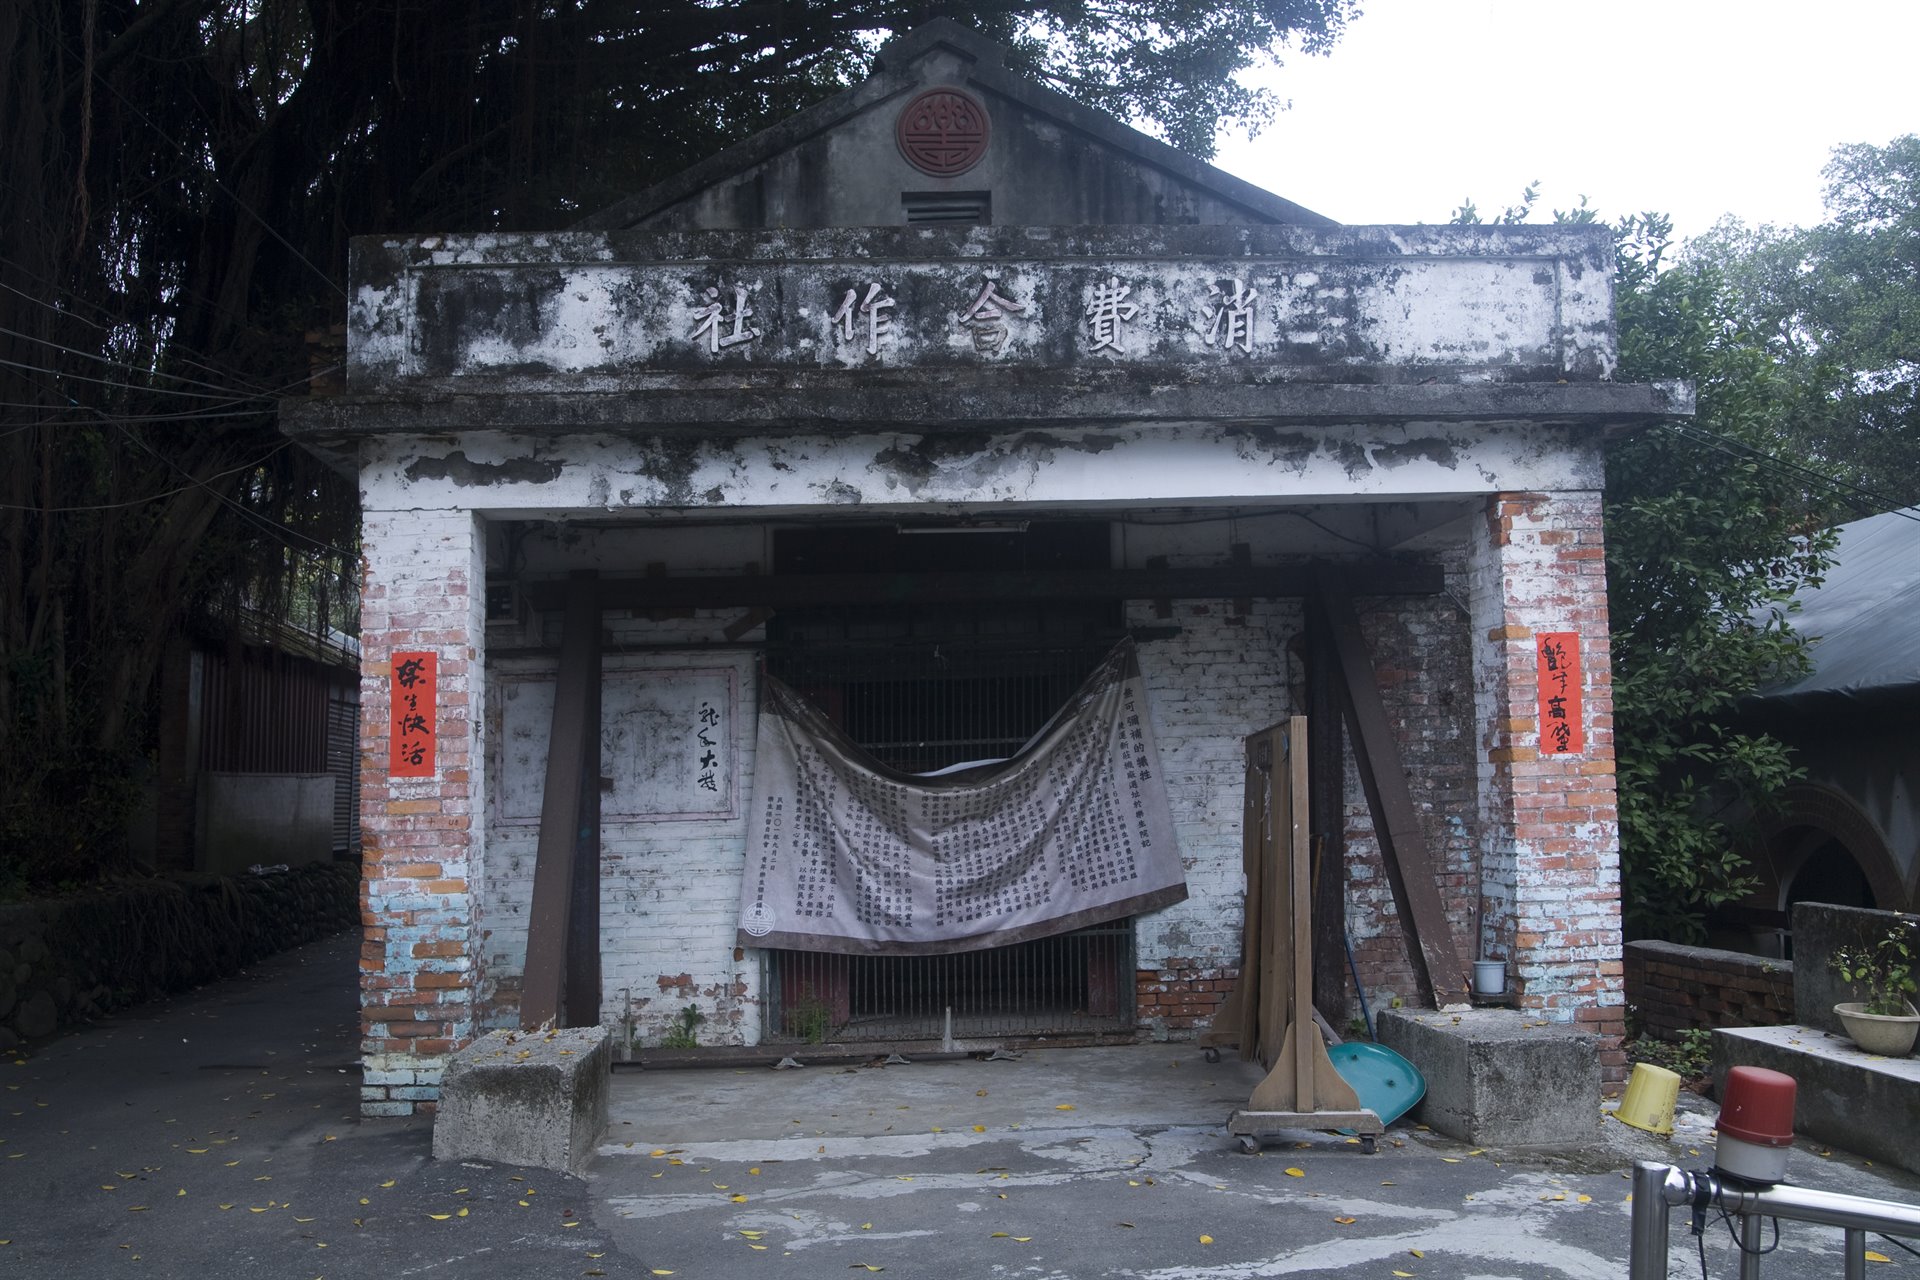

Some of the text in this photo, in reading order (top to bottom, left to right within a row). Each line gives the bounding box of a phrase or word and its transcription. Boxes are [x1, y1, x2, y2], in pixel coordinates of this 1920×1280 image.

[1123, 687, 1152, 782] 無可彌補的犧牲
